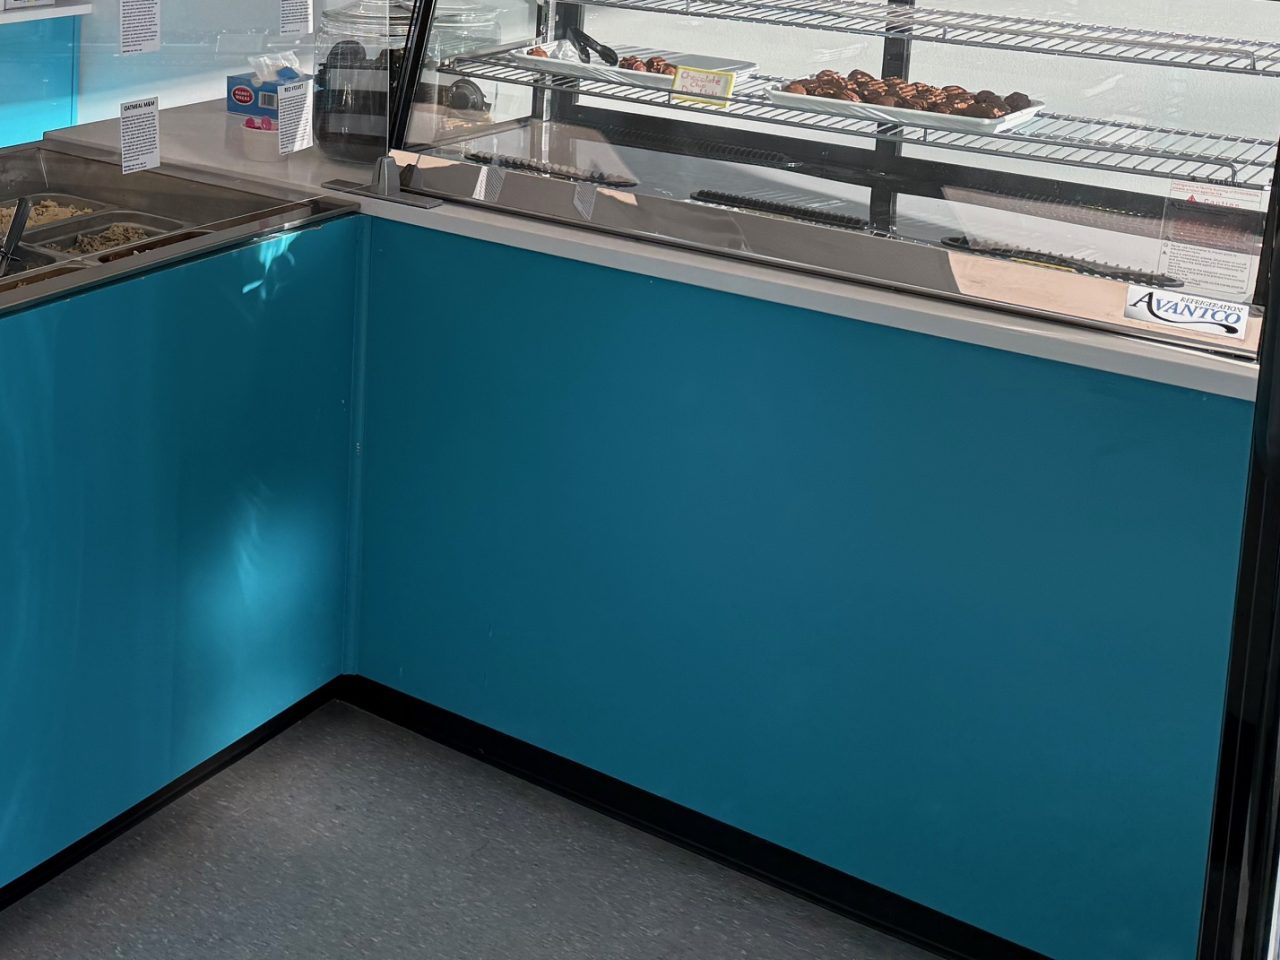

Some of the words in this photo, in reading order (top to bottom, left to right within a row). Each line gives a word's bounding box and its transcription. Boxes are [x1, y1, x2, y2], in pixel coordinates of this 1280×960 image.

[123, 102, 143, 111] OATMEAL
[1130, 291, 1242, 328] AVANTCO
[1180, 296, 1244, 313] REFRIGERATION
